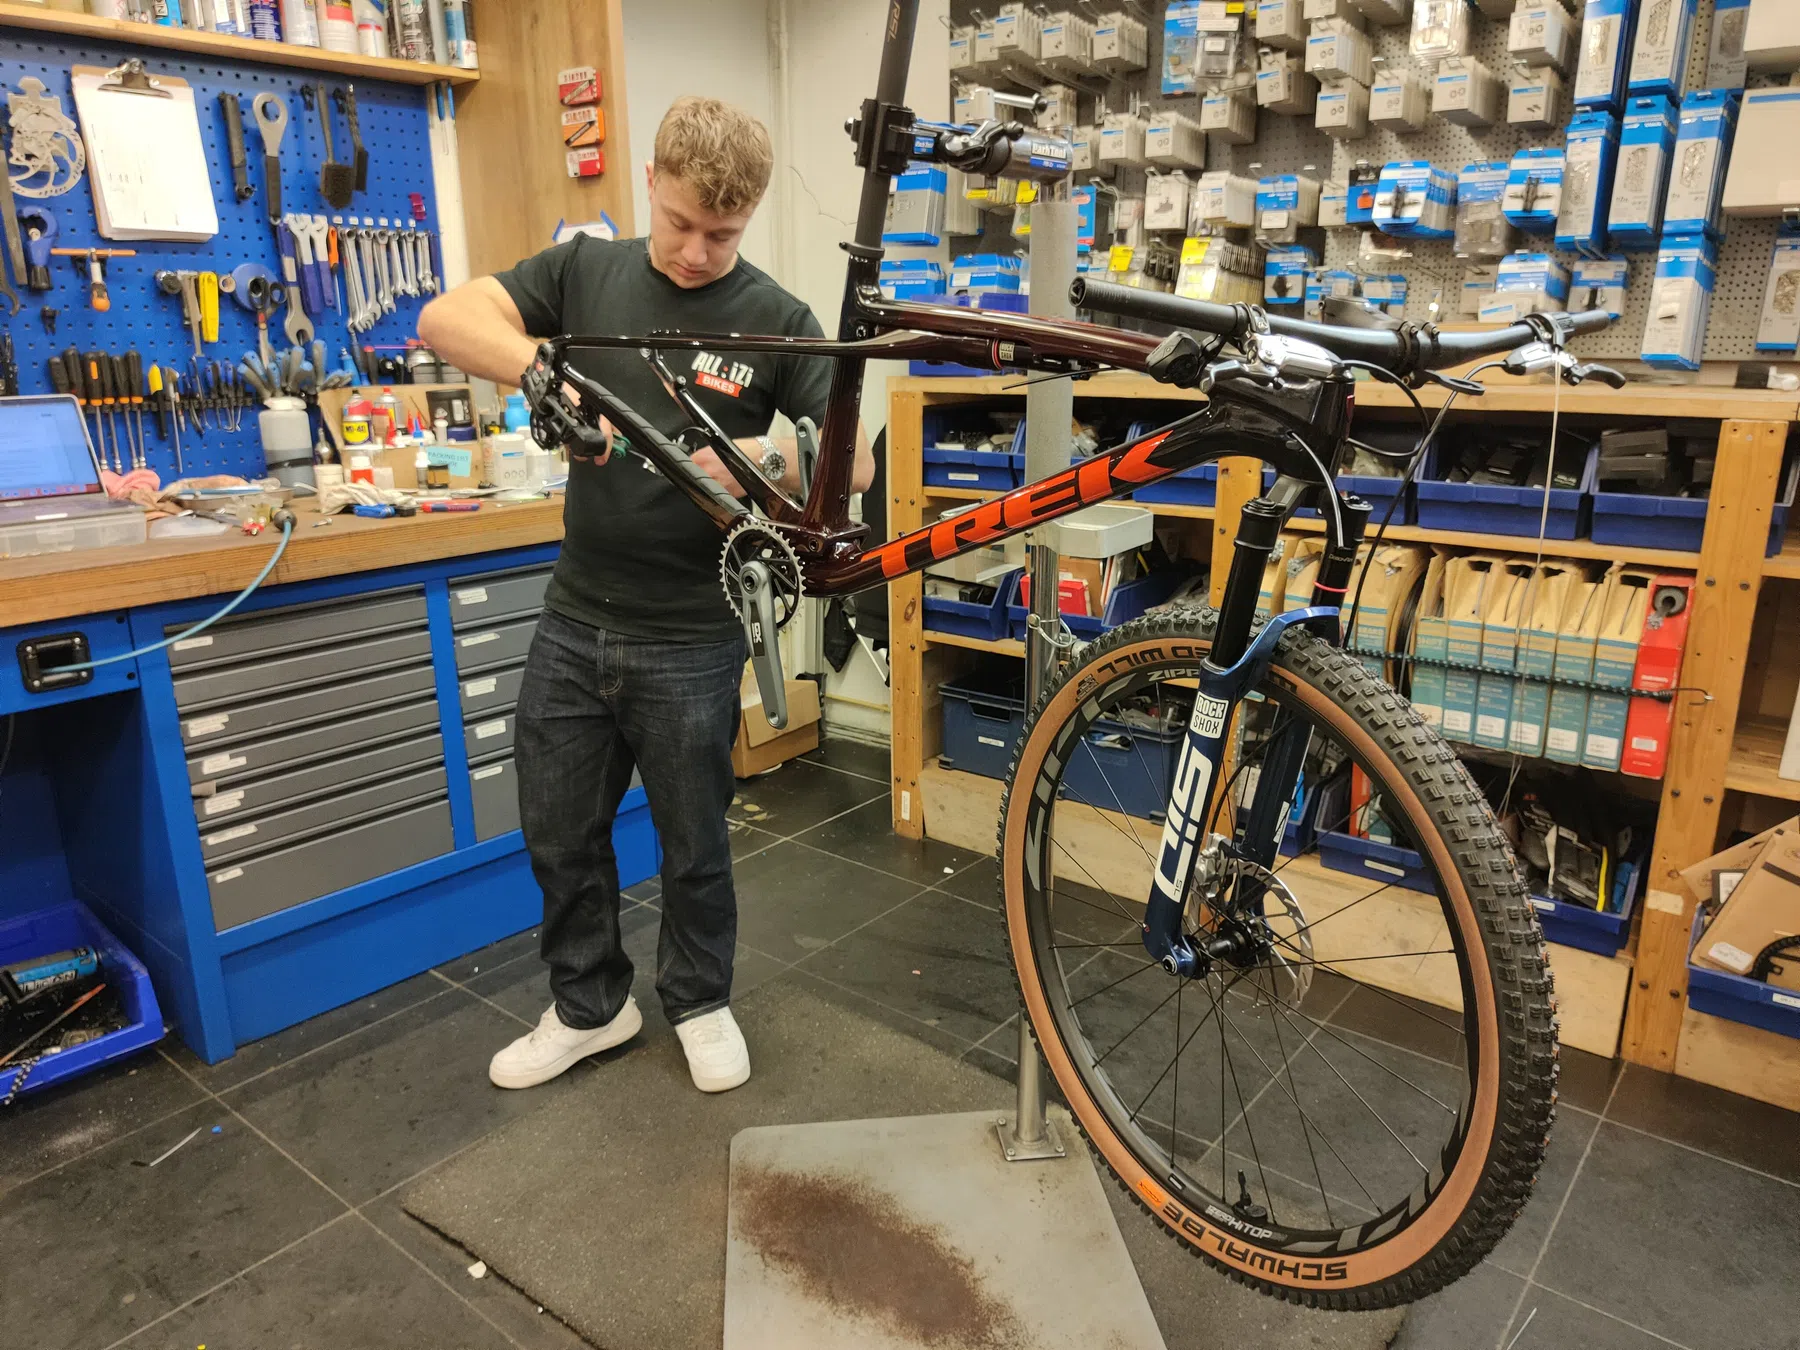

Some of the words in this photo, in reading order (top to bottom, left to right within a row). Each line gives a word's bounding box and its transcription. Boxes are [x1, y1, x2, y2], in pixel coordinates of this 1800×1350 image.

[701, 375, 736, 394] BIKES
[860, 429, 1175, 579] TREK
[1097, 647, 1166, 675] WILL
[1195, 695, 1226, 719] ROCK
[1193, 715, 1220, 735] SHOX
[1162, 1202, 1348, 1281] SCHWALBE
